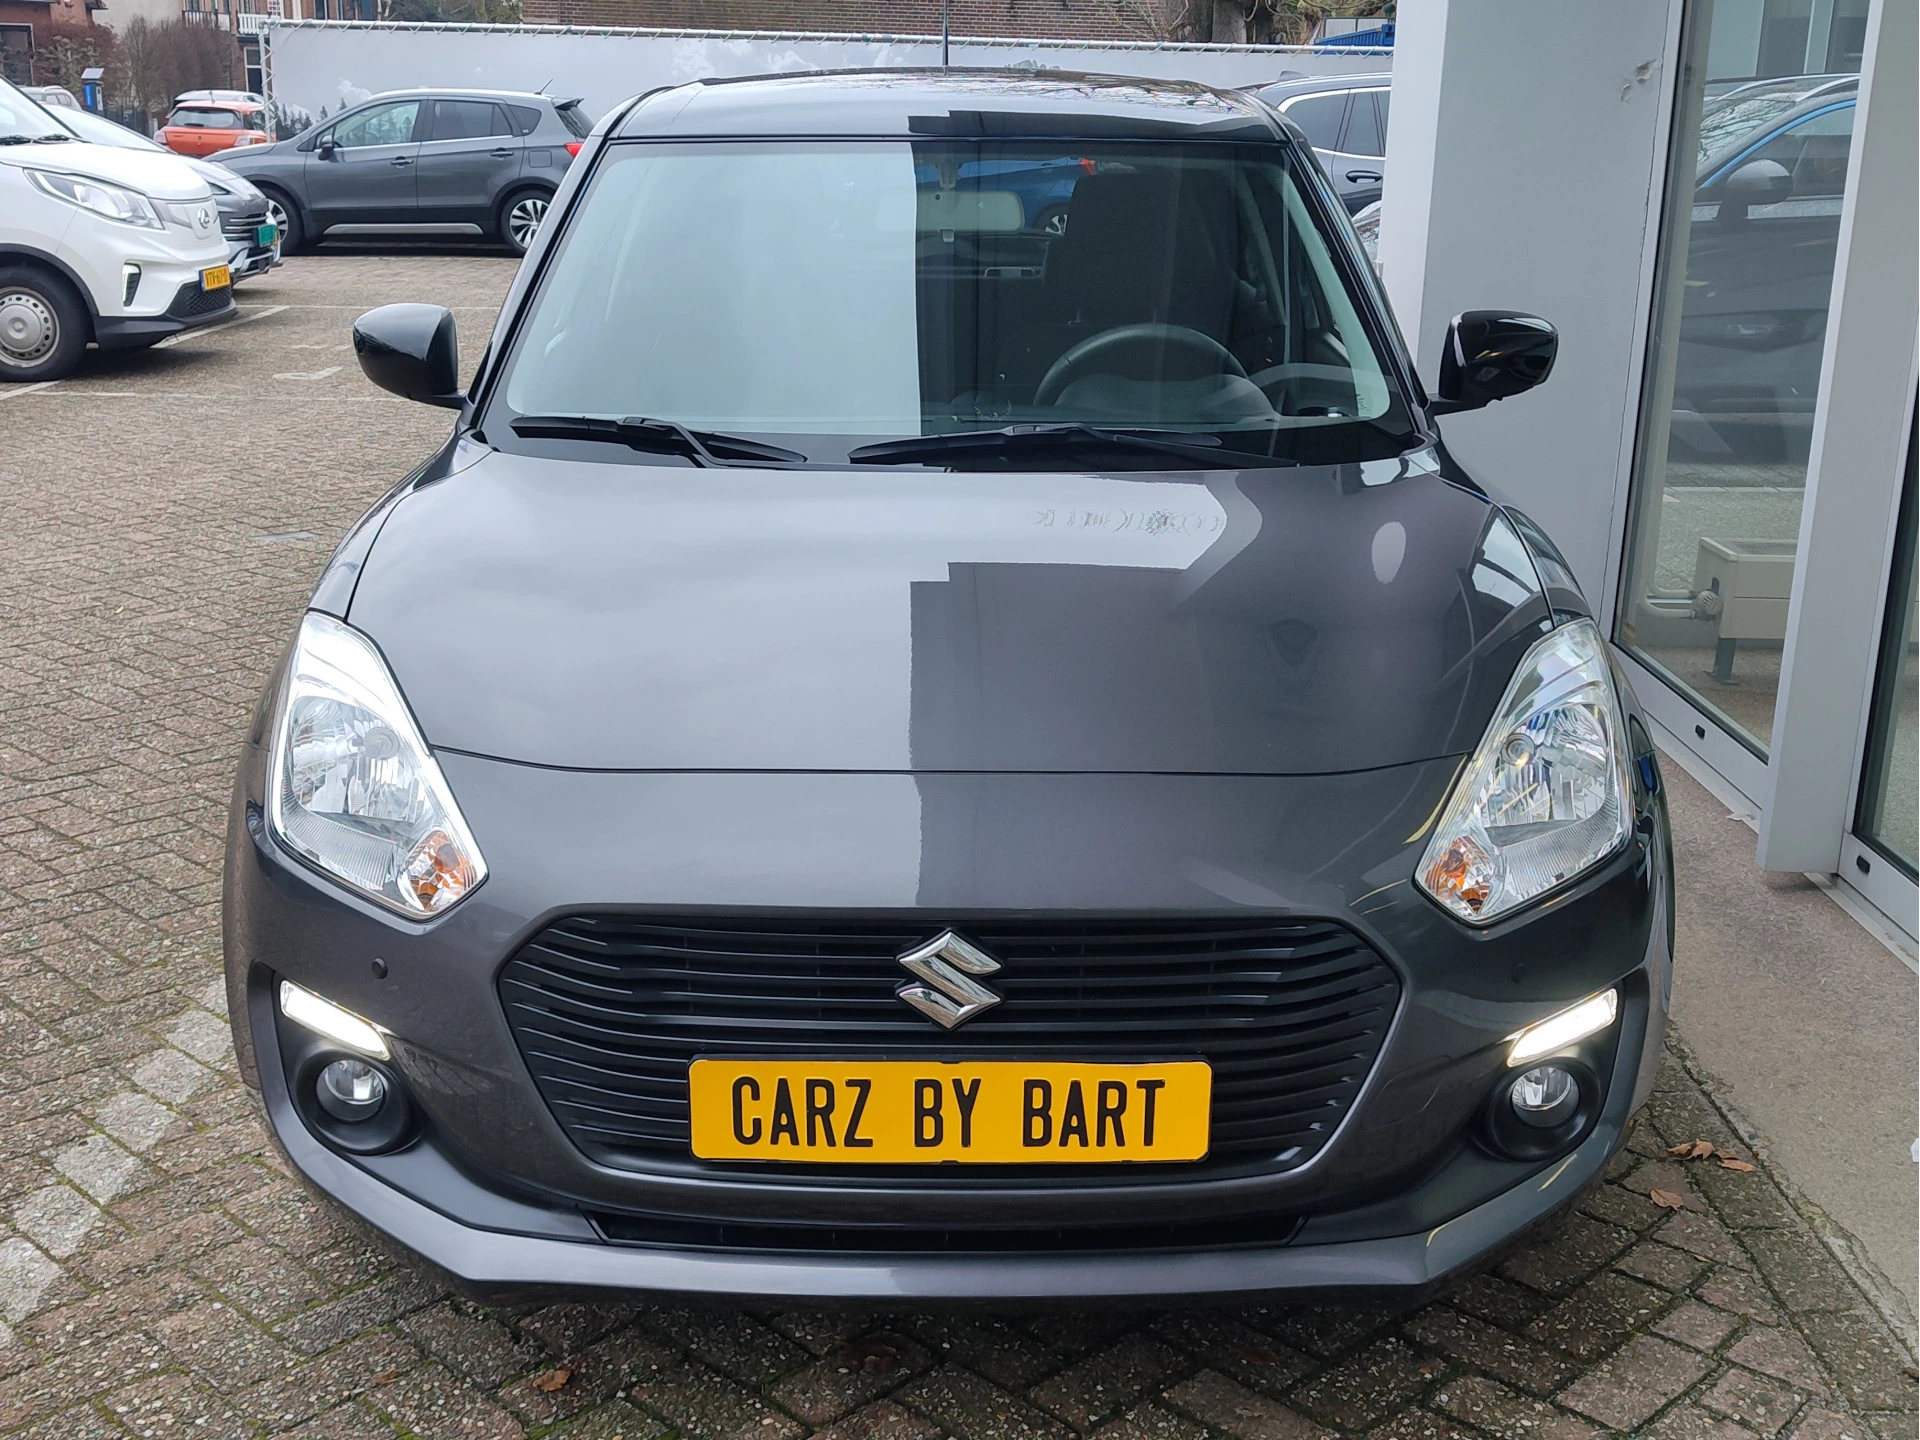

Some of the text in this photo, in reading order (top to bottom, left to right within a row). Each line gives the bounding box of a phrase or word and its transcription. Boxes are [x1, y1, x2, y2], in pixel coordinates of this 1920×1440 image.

[731, 1075, 1167, 1148] CARZ BY BART
